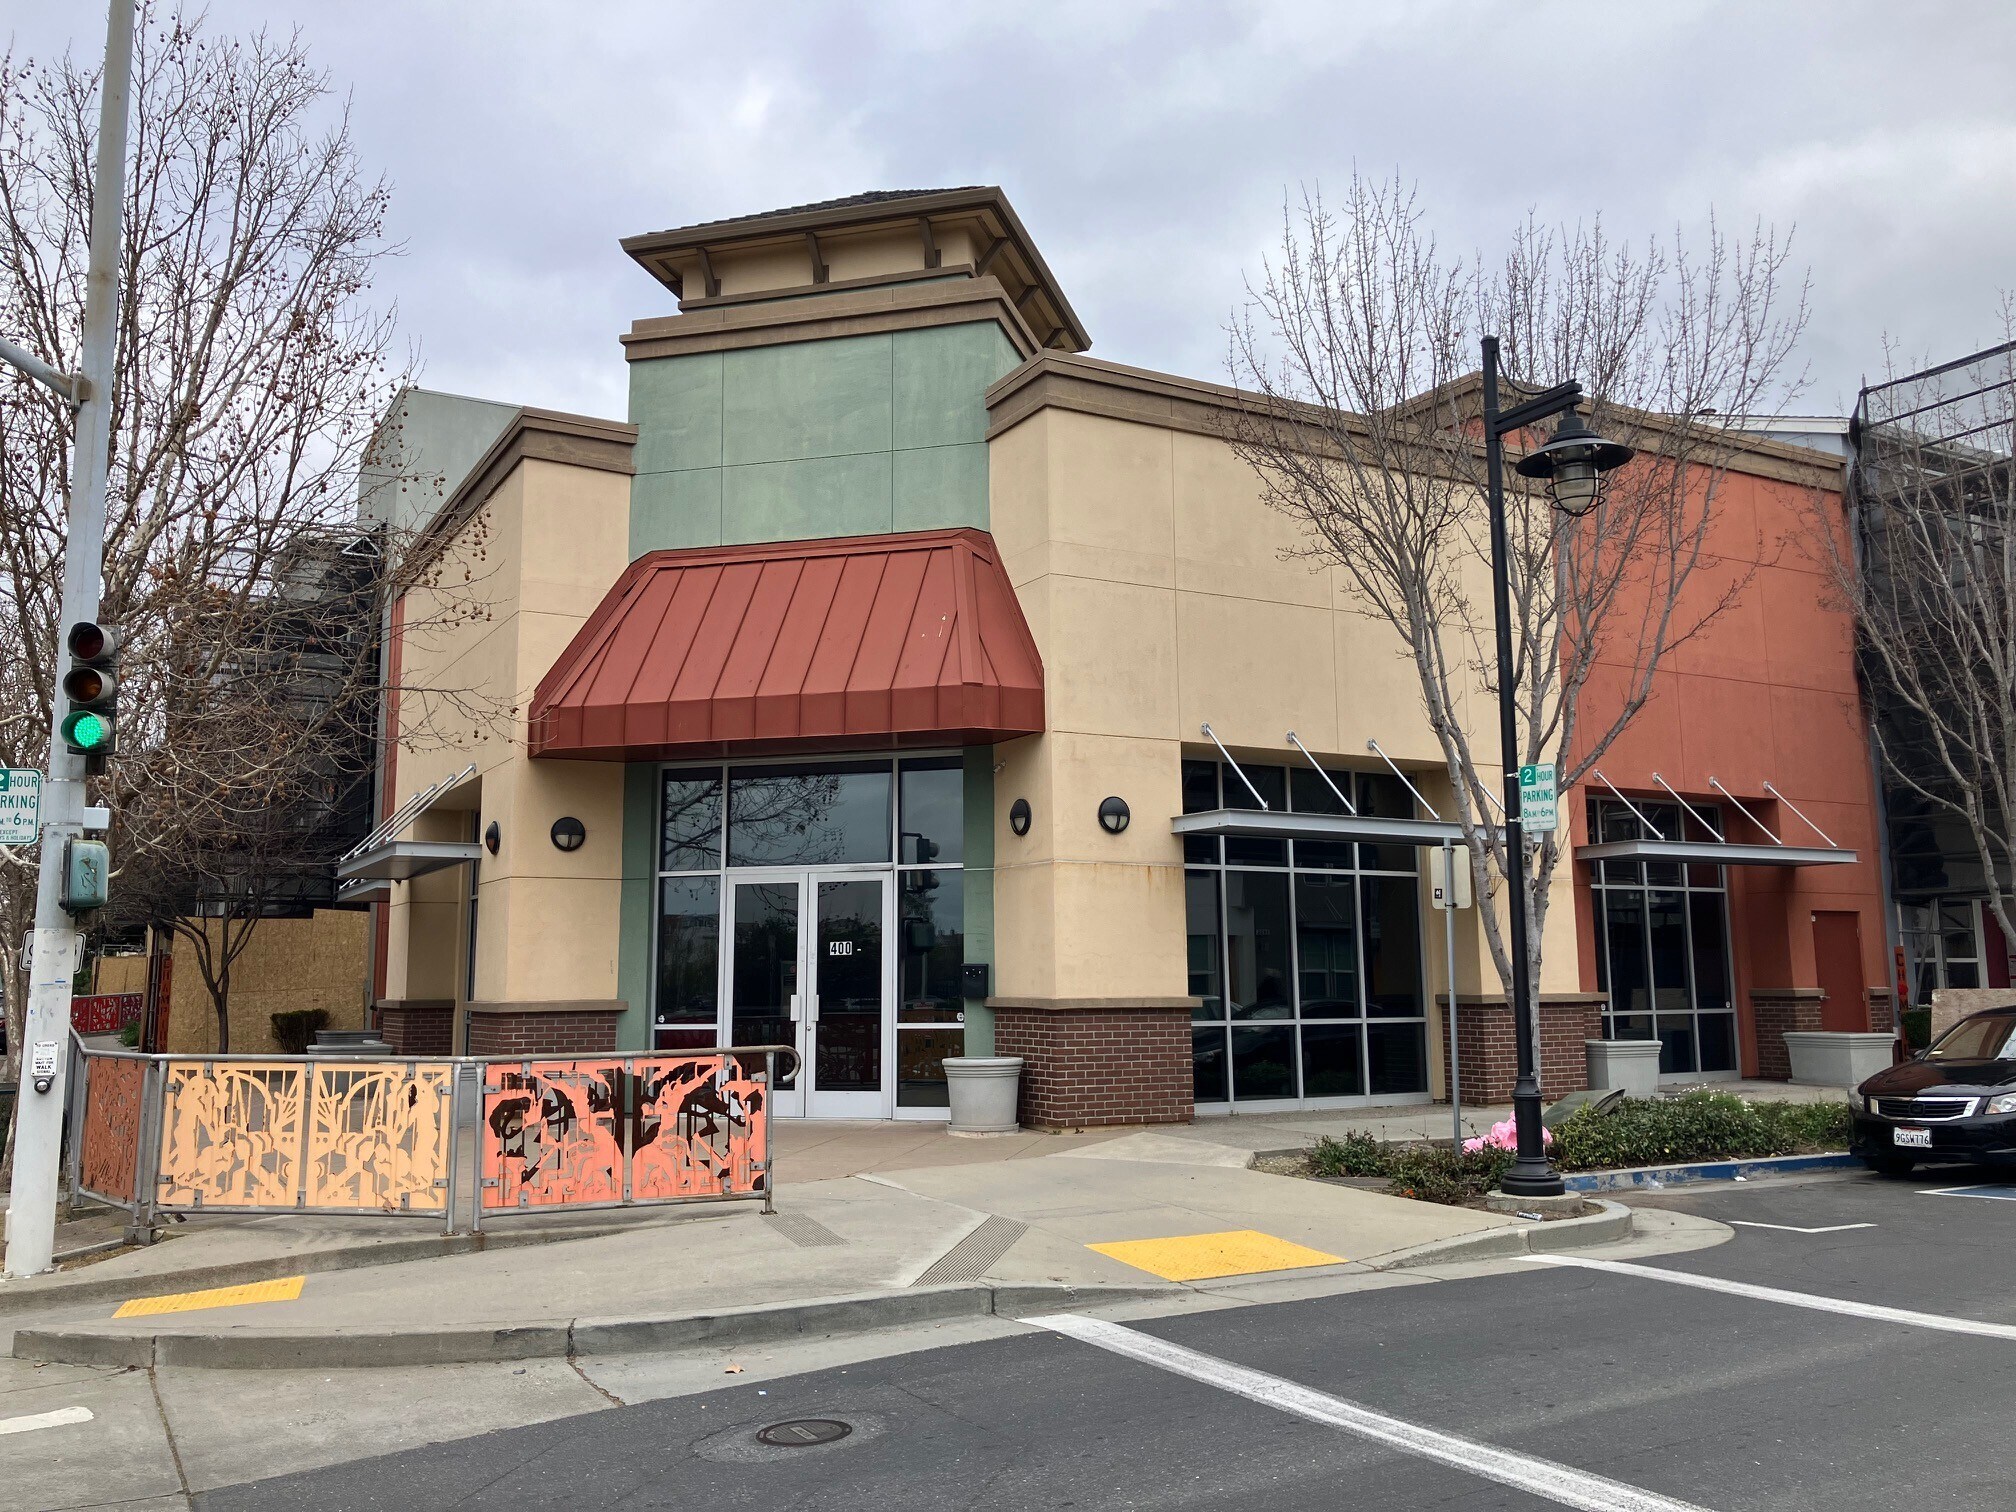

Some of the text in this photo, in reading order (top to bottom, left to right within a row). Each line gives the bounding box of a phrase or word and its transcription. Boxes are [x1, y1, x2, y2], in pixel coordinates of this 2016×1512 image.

[10, 776, 38, 788] HOUR
[1524, 768, 1552, 783] 2 HOUR
[1523, 789, 1553, 802] PARKING
[830, 942, 851, 955] 400
[1895, 1133, 1929, 1145] 9GSW776
